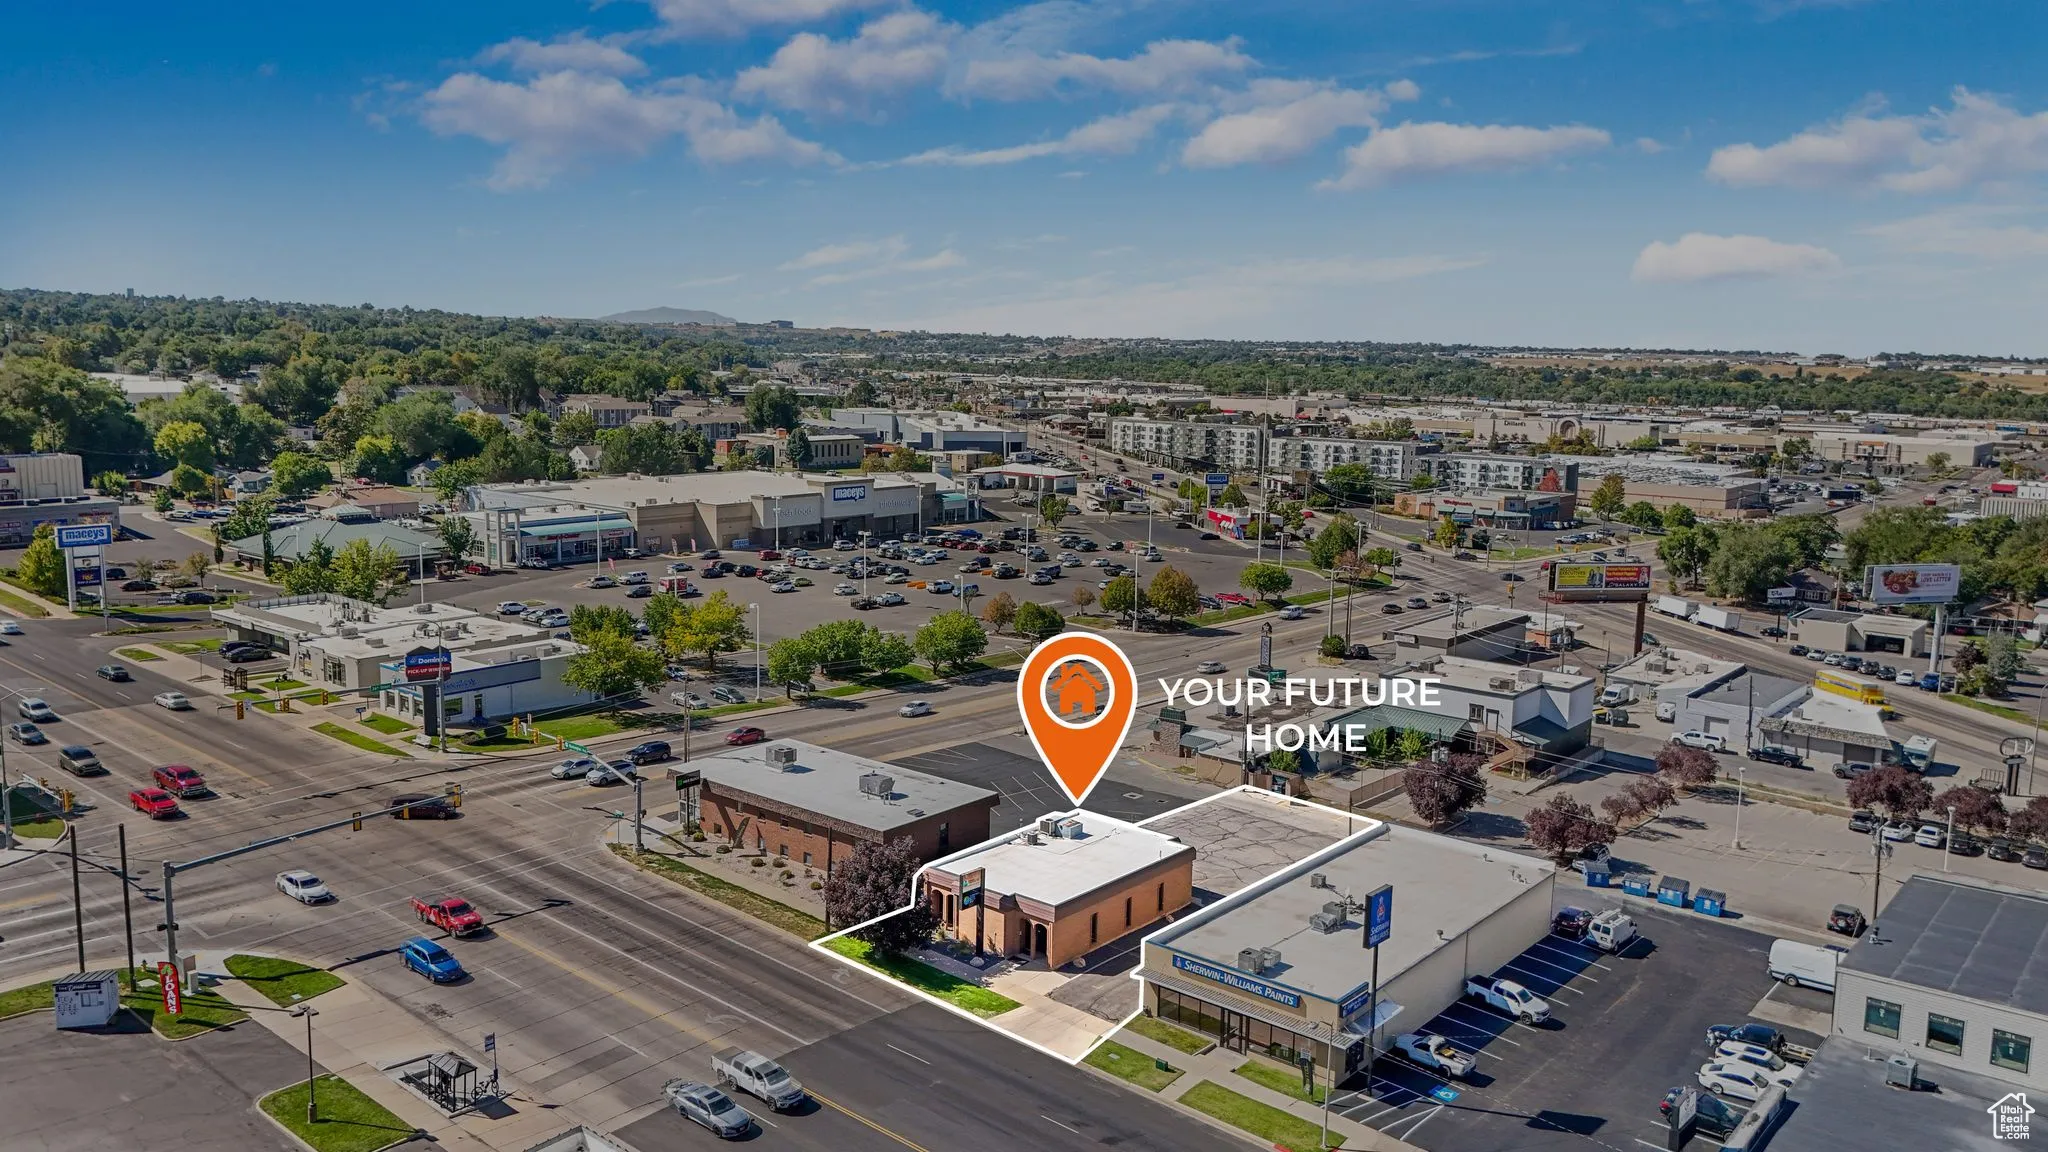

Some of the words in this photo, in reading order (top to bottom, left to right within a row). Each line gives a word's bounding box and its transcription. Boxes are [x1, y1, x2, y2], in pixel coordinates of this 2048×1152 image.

[834, 487, 865, 500] maceys
[65, 528, 105, 540] maceys
[418, 656, 448, 665] Domino's
[165, 975, 177, 1015] LOANS
[1264, 987, 1294, 1005] PAINTS
